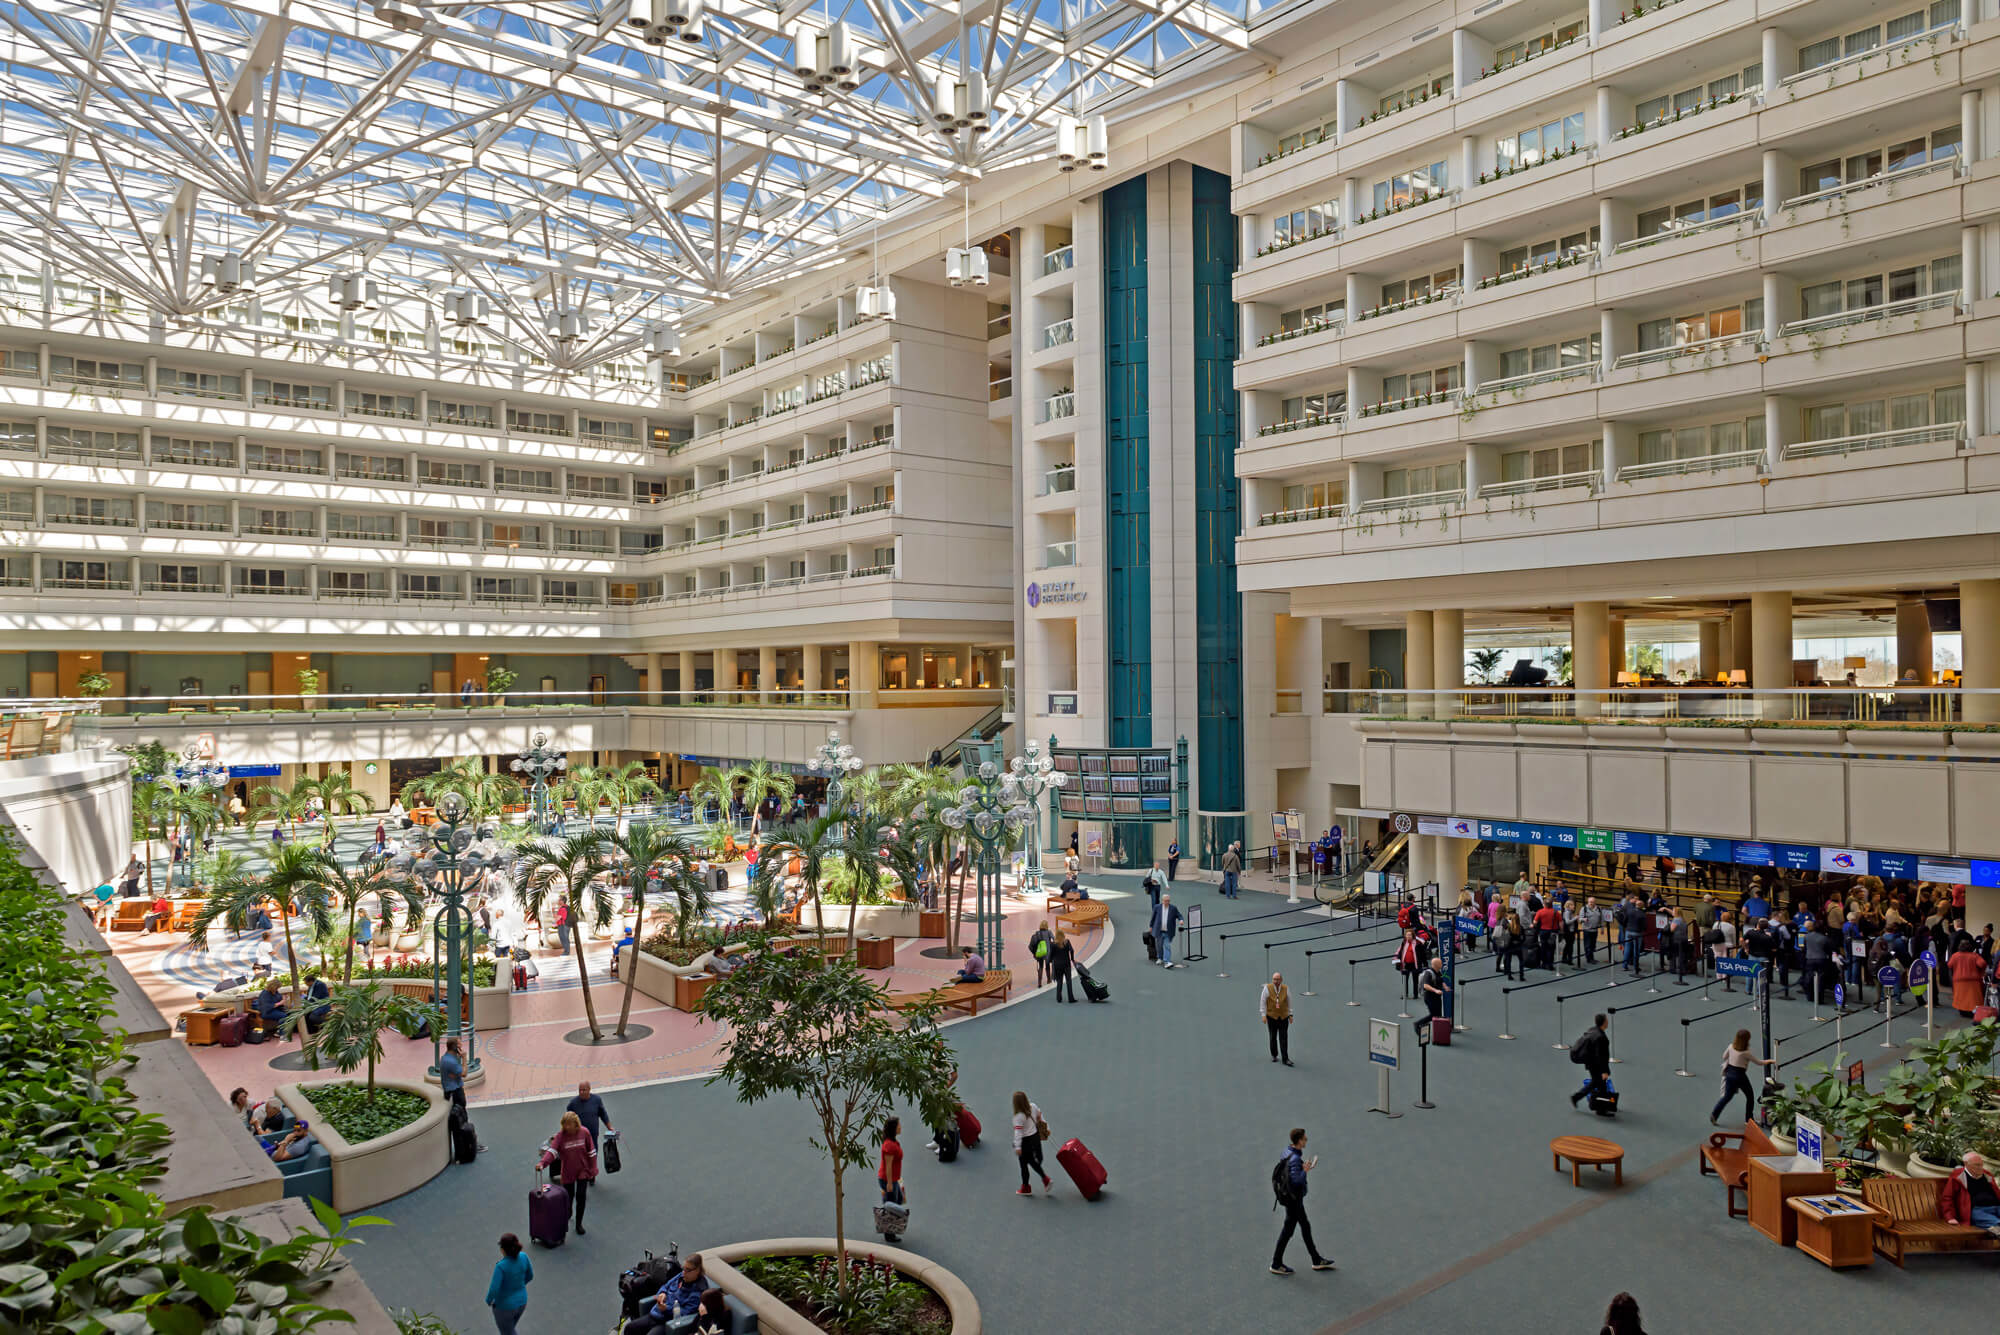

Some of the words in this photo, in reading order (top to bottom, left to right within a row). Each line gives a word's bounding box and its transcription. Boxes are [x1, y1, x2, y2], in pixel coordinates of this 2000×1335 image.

[1042, 582, 1075, 592] HYATT
[1042, 592, 1087, 604] REGENCY
[1496, 828, 1520, 838] Gates
[1530, 831, 1541, 840] 70
[1558, 833, 1574, 842] 129
[1458, 920, 1467, 929] TSA
[1468, 923, 1477, 931] Pre
[1719, 962, 1733, 970] TSA
[1735, 963, 1749, 972] Pre
